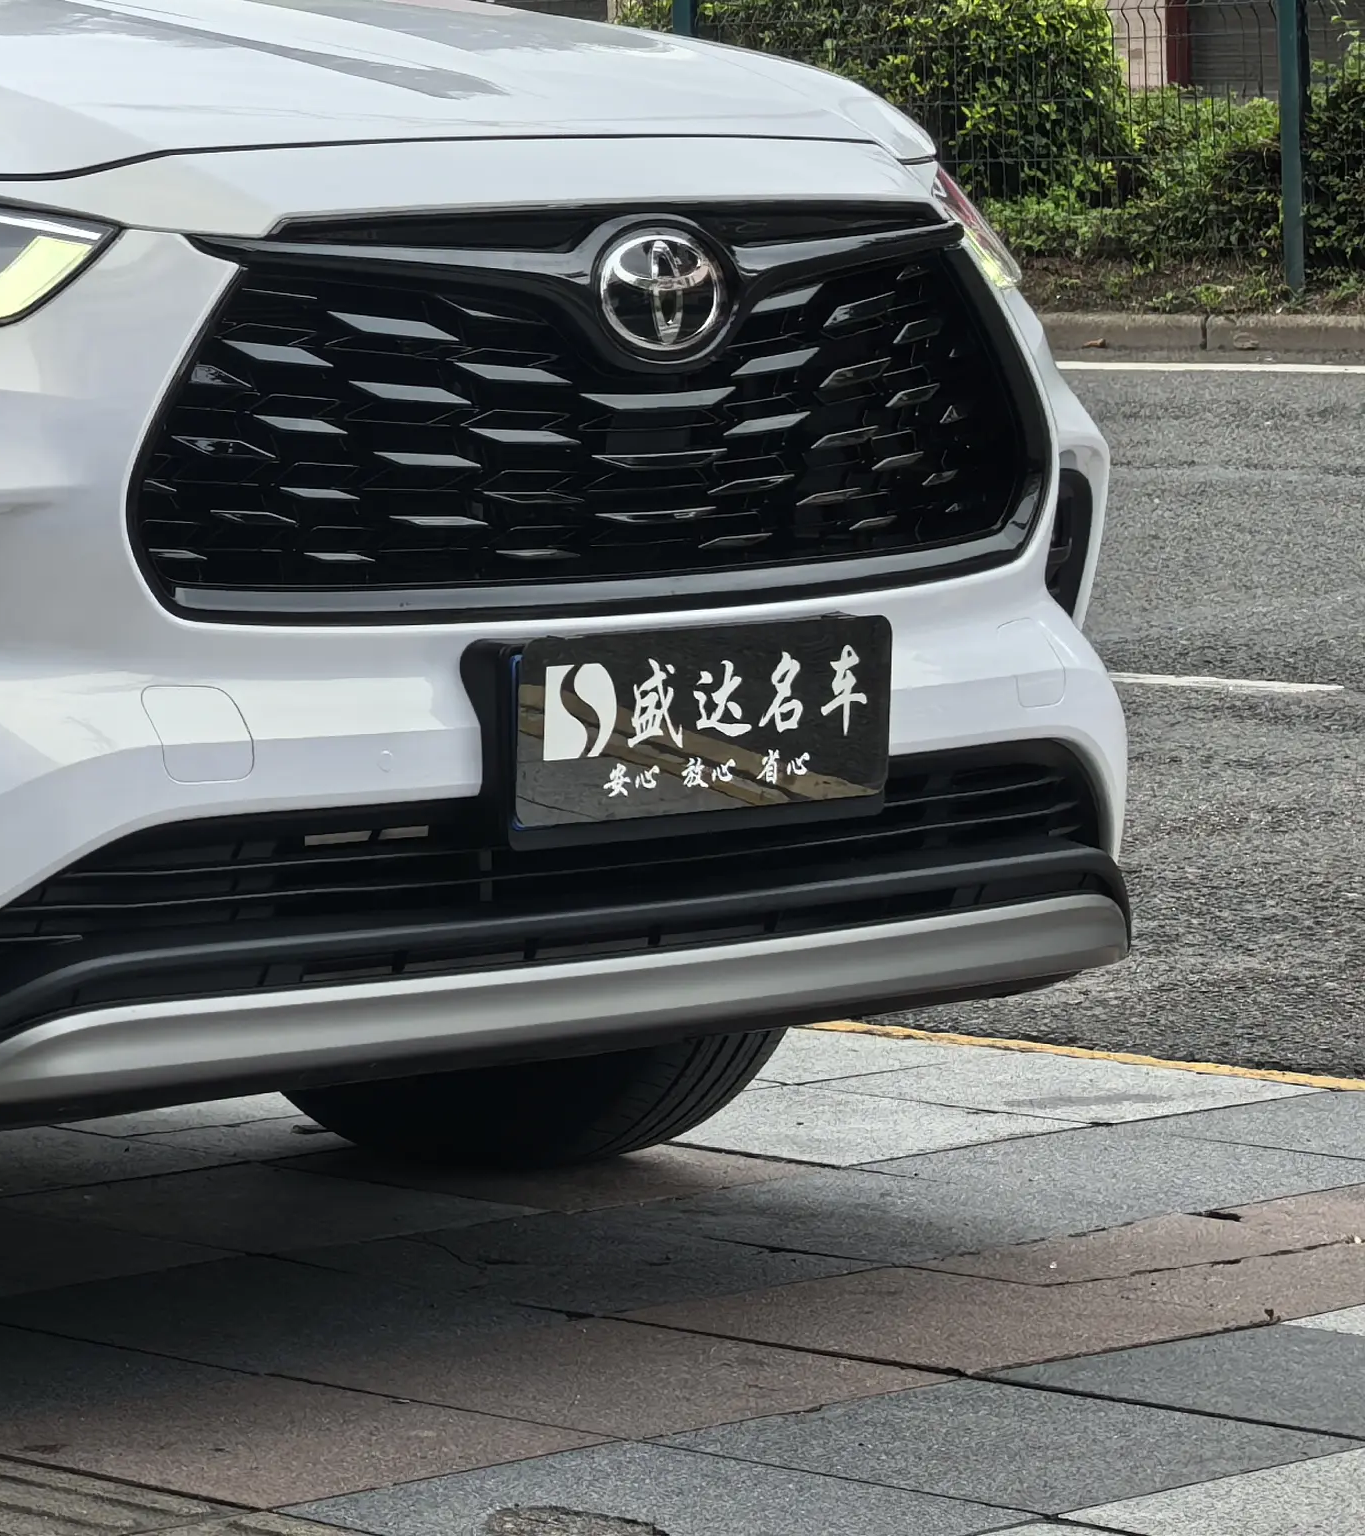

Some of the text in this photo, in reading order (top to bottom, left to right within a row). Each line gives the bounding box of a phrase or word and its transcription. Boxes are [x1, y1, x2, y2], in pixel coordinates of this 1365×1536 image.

[626, 643, 869, 750] 盛达名车
[602, 748, 812, 798] 安心 放心 省心
